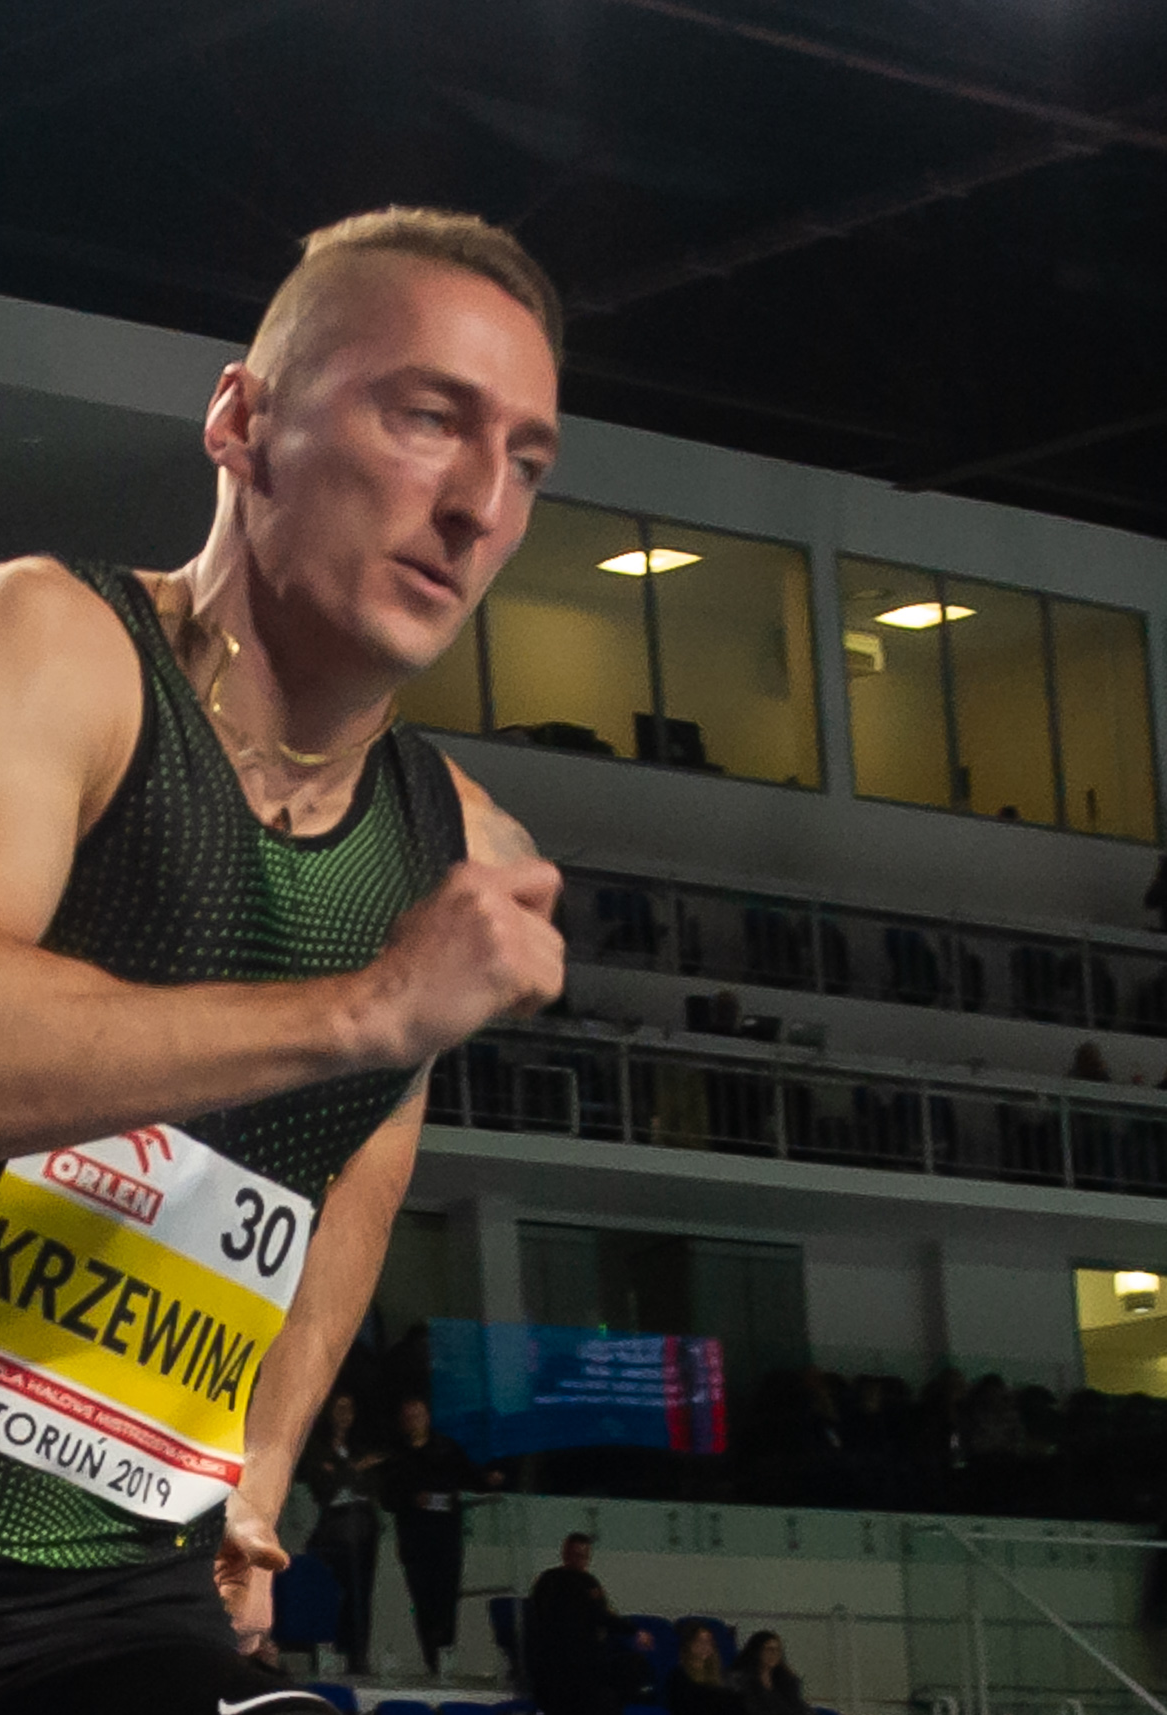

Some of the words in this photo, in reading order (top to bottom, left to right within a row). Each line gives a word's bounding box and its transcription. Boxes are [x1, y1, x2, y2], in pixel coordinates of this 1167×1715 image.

[48, 1151, 160, 1222] ORLEN
[220, 1187, 296, 1277] 30
[107, 1459, 171, 1508] 2019
